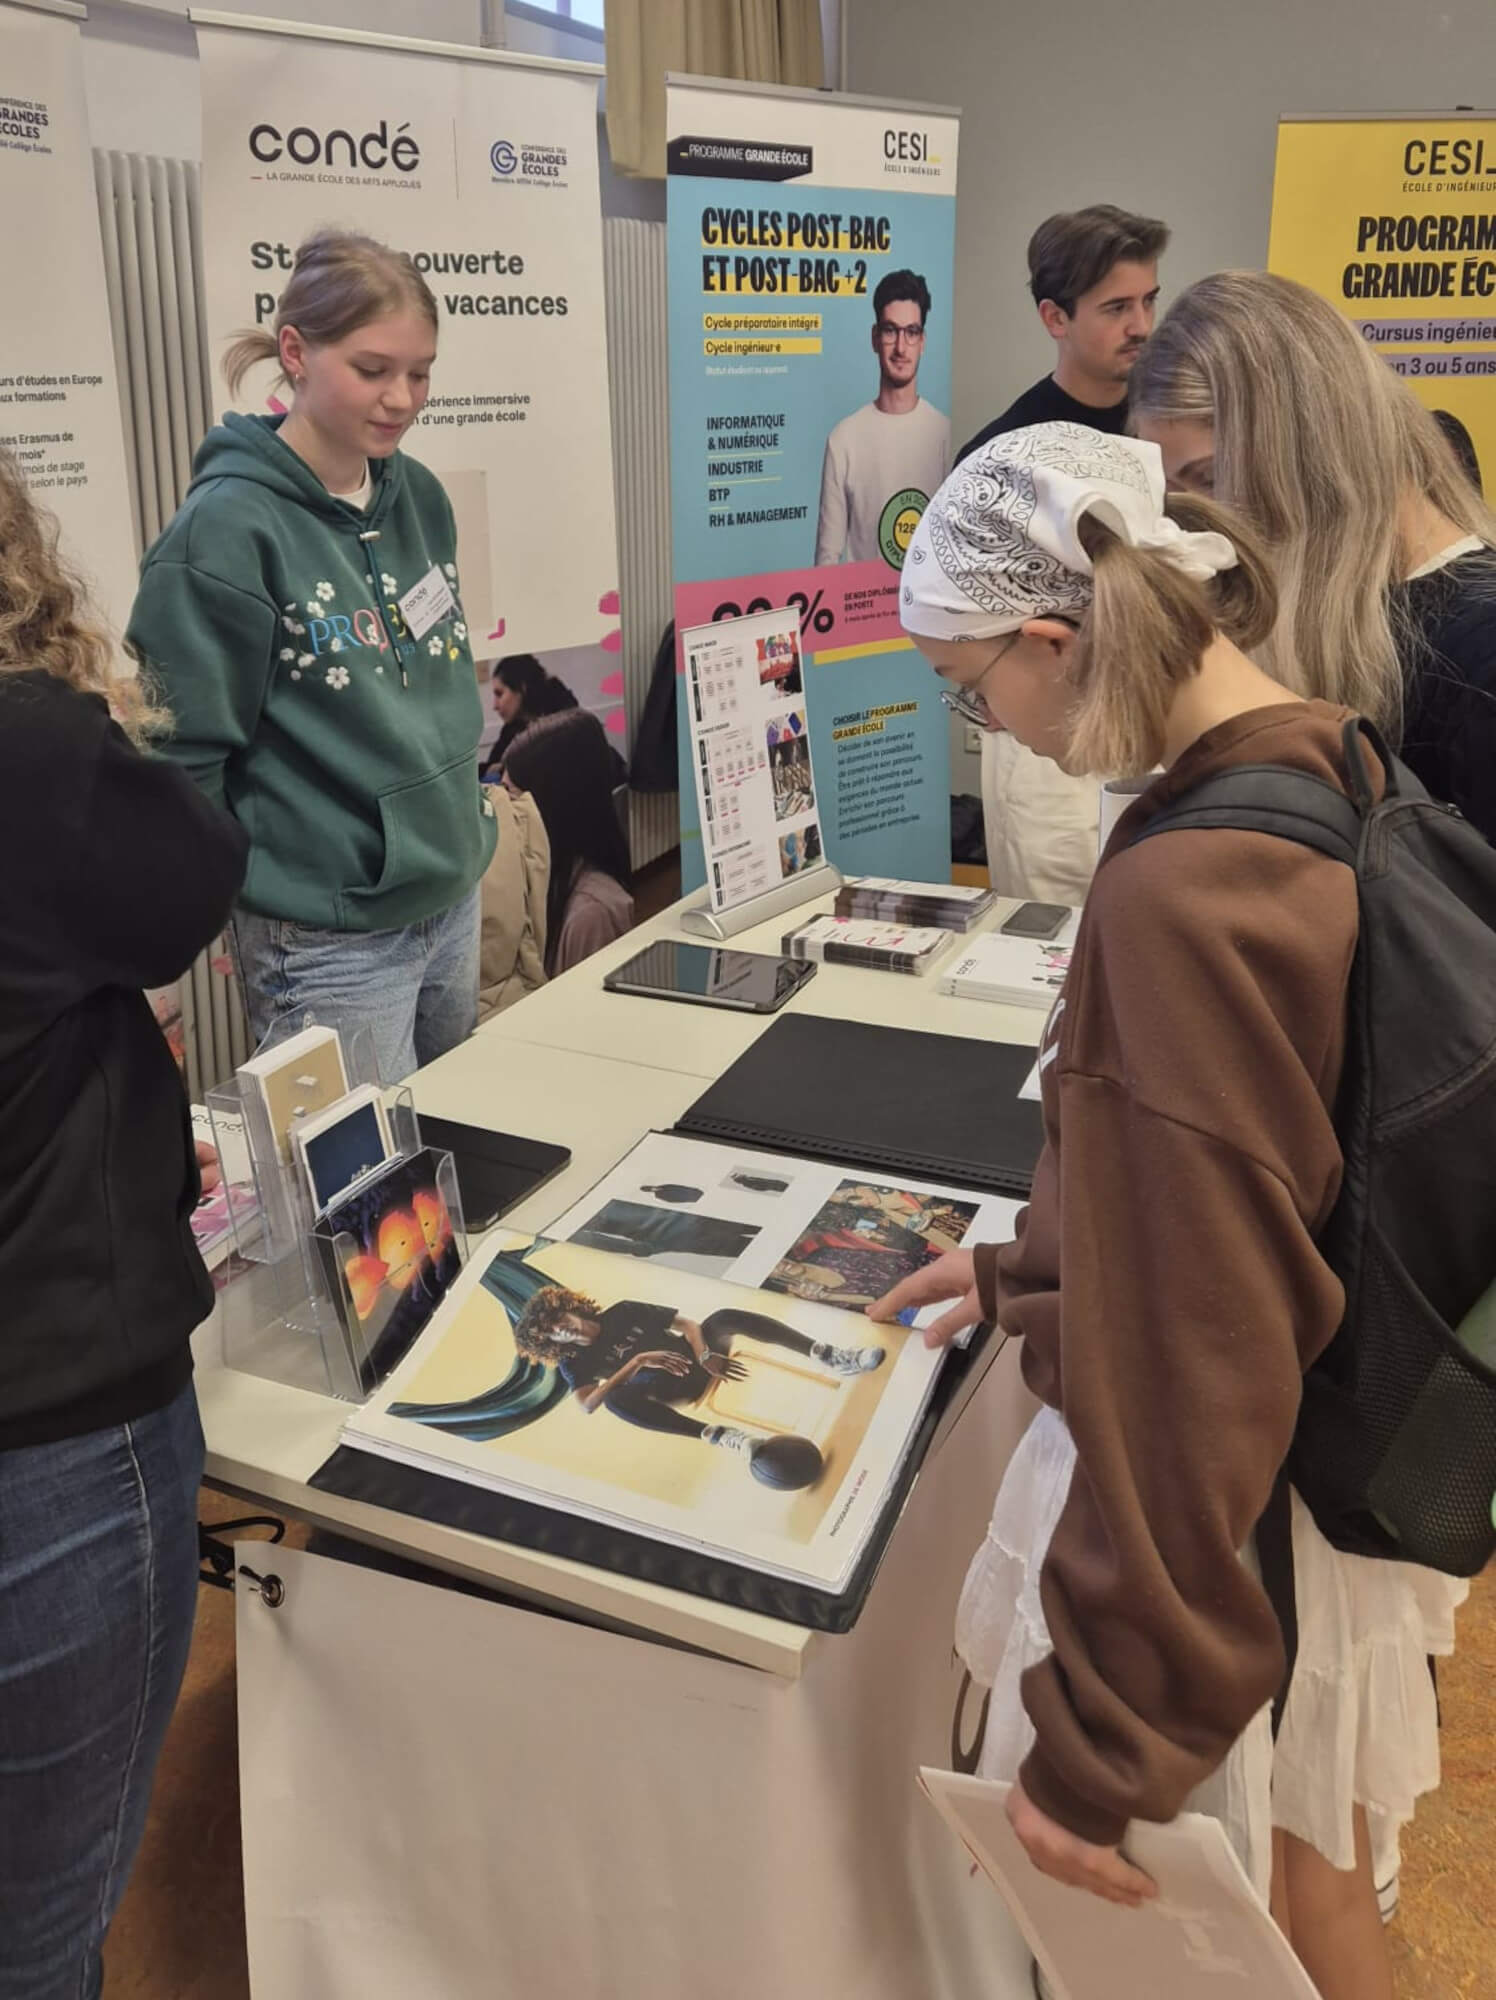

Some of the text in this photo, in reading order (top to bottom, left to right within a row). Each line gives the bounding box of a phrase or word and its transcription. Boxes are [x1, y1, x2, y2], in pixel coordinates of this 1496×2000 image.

[0, 107, 48, 126] RANDES
[249, 121, 420, 172] condé
[883, 129, 928, 162] CESI
[521, 152, 567, 166] GRANDES
[689, 144, 809, 166] PROGRAMME GRANDE ÉCOLE
[522, 163, 559, 176] ÉCOLES
[266, 172, 278, 181] LA
[279, 173, 315, 183] GRANDE
[346, 176, 361, 186] DES
[1402, 180, 1433, 192] ÉCOLE
[702, 206, 891, 251] CYCLES POST-BAC
[413, 249, 524, 275] ouverte
[702, 254, 867, 294] ET POST-BAC +2
[1342, 261, 1457, 299] GRANDE
[444, 293, 568, 316] vacances
[705, 315, 819, 331] Cycle préparatoire intégré
[1362, 323, 1424, 341] Cursus
[705, 341, 732, 356] Cycle
[1410, 357, 1422, 375] 3
[1424, 361, 1448, 375] ou
[1451, 356, 1463, 375] 5
[1465, 360, 1496, 374] ans
[16, 375, 58, 387] d'études
[58, 376, 71, 385] en
[71, 374, 103, 388] Europe
[14, 391, 66, 402] formations
[424, 392, 530, 408] périence immersive
[422, 413, 455, 425] d'une
[456, 411, 494, 427] grande
[495, 410, 526, 422] école
[707, 413, 785, 431] INFORMATIQUE
[19, 433, 60, 445] Erasmus
[62, 432, 74, 442] de
[708, 431, 779, 450] & NUMÉRIQUE
[47, 462, 58, 473] de
[60, 461, 85, 473] stage
[708, 459, 763, 477] INDUSTRIE
[56, 477, 64, 487] le
[66, 476, 88, 488] pays
[708, 488, 730, 502] BTP
[709, 506, 808, 528] RH & MANAGEMENT
[832, 701, 918, 727] CHOISIR LE PROGRAMME
[832, 721, 884, 741] GRANDE ÉCOLE
